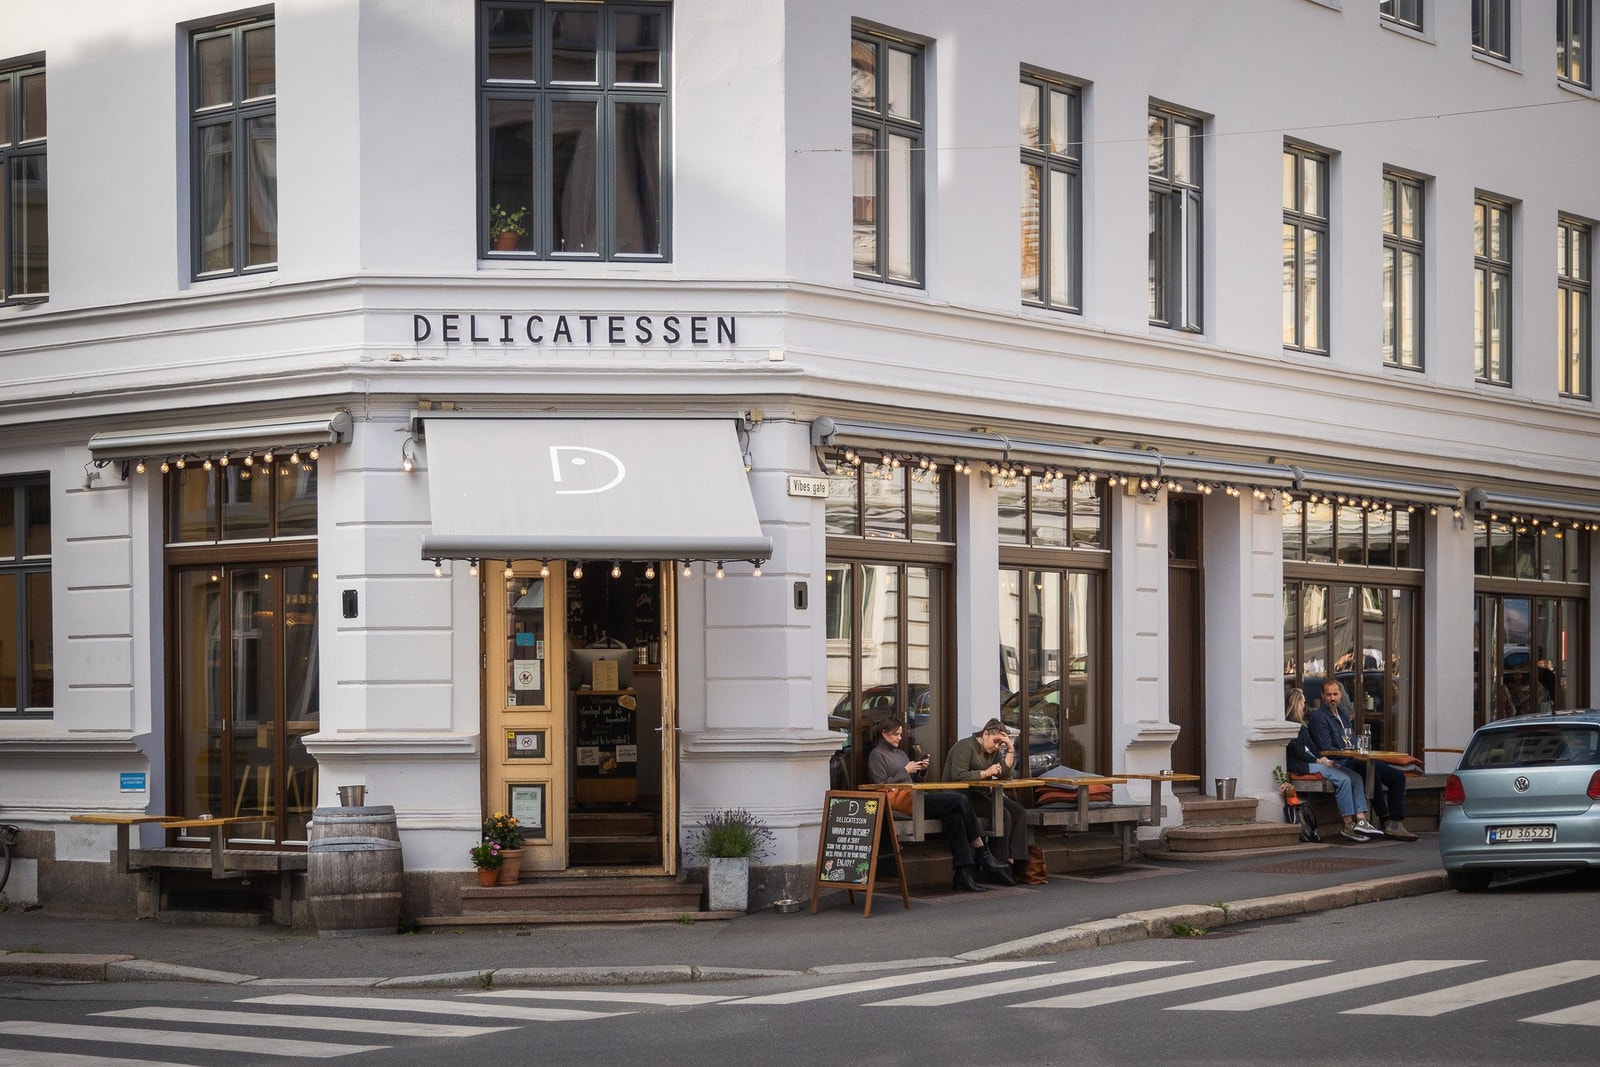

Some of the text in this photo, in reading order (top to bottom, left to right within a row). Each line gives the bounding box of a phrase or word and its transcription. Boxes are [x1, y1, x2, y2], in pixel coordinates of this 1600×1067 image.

[413, 314, 737, 344] DELICATESSEN
[793, 479, 826, 495] Vibes gate
[836, 816, 867, 824] DELICATESSEN
[832, 827, 845, 835] WANNA
[852, 828, 870, 837] OUTSIDE?
[1499, 827, 1550, 838] PD 36523
[837, 858, 855, 867] ENJOY!
